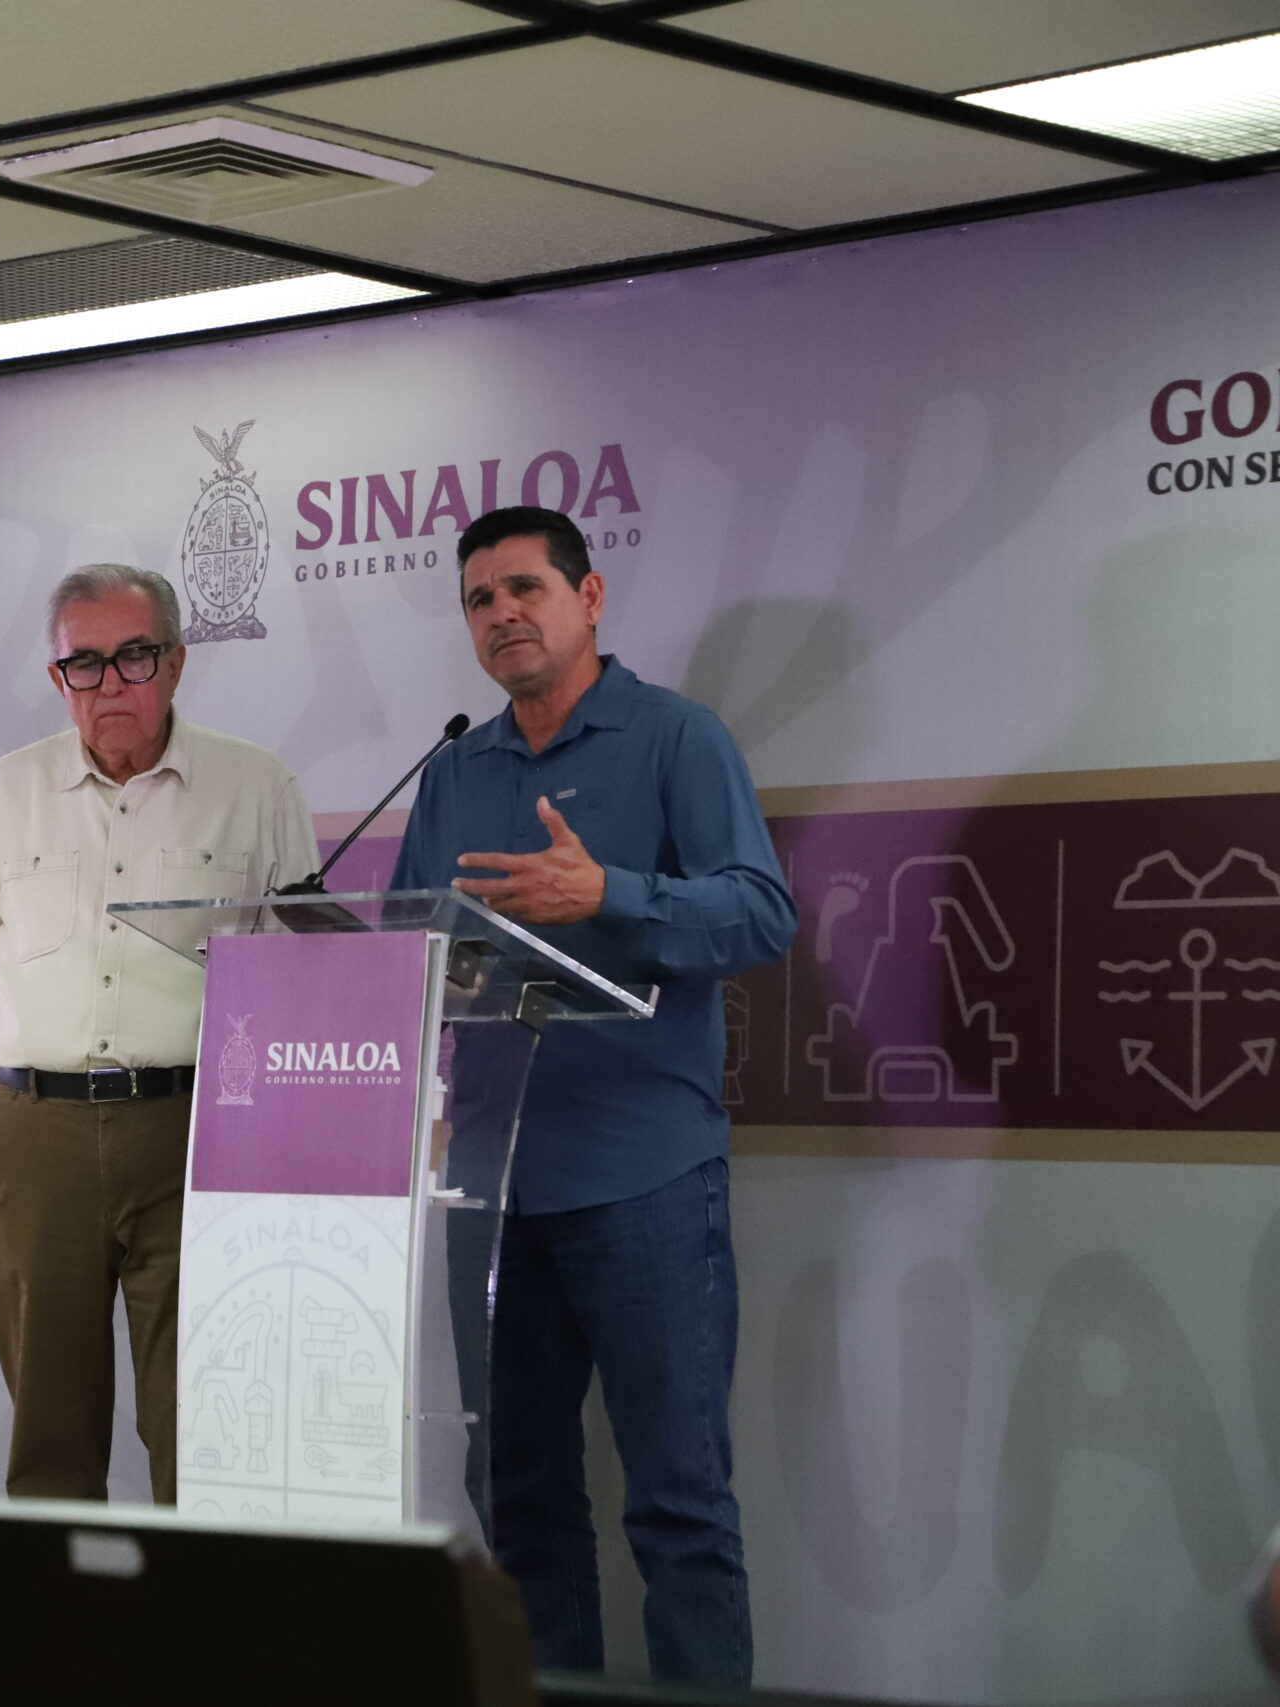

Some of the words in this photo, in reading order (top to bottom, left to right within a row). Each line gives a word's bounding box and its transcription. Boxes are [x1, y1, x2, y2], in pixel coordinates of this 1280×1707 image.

[1147, 455, 1235, 496] CON
[209, 484, 246, 500] SINALOA
[295, 549, 438, 583] GOBIERNO
[266, 1042, 401, 1071] SINALOA
[265, 1075, 325, 1085] GOBIERNO
[330, 1075, 351, 1085] DEL
[356, 1075, 401, 1085] ESTADO
[222, 1214, 370, 1273] SINALOA
